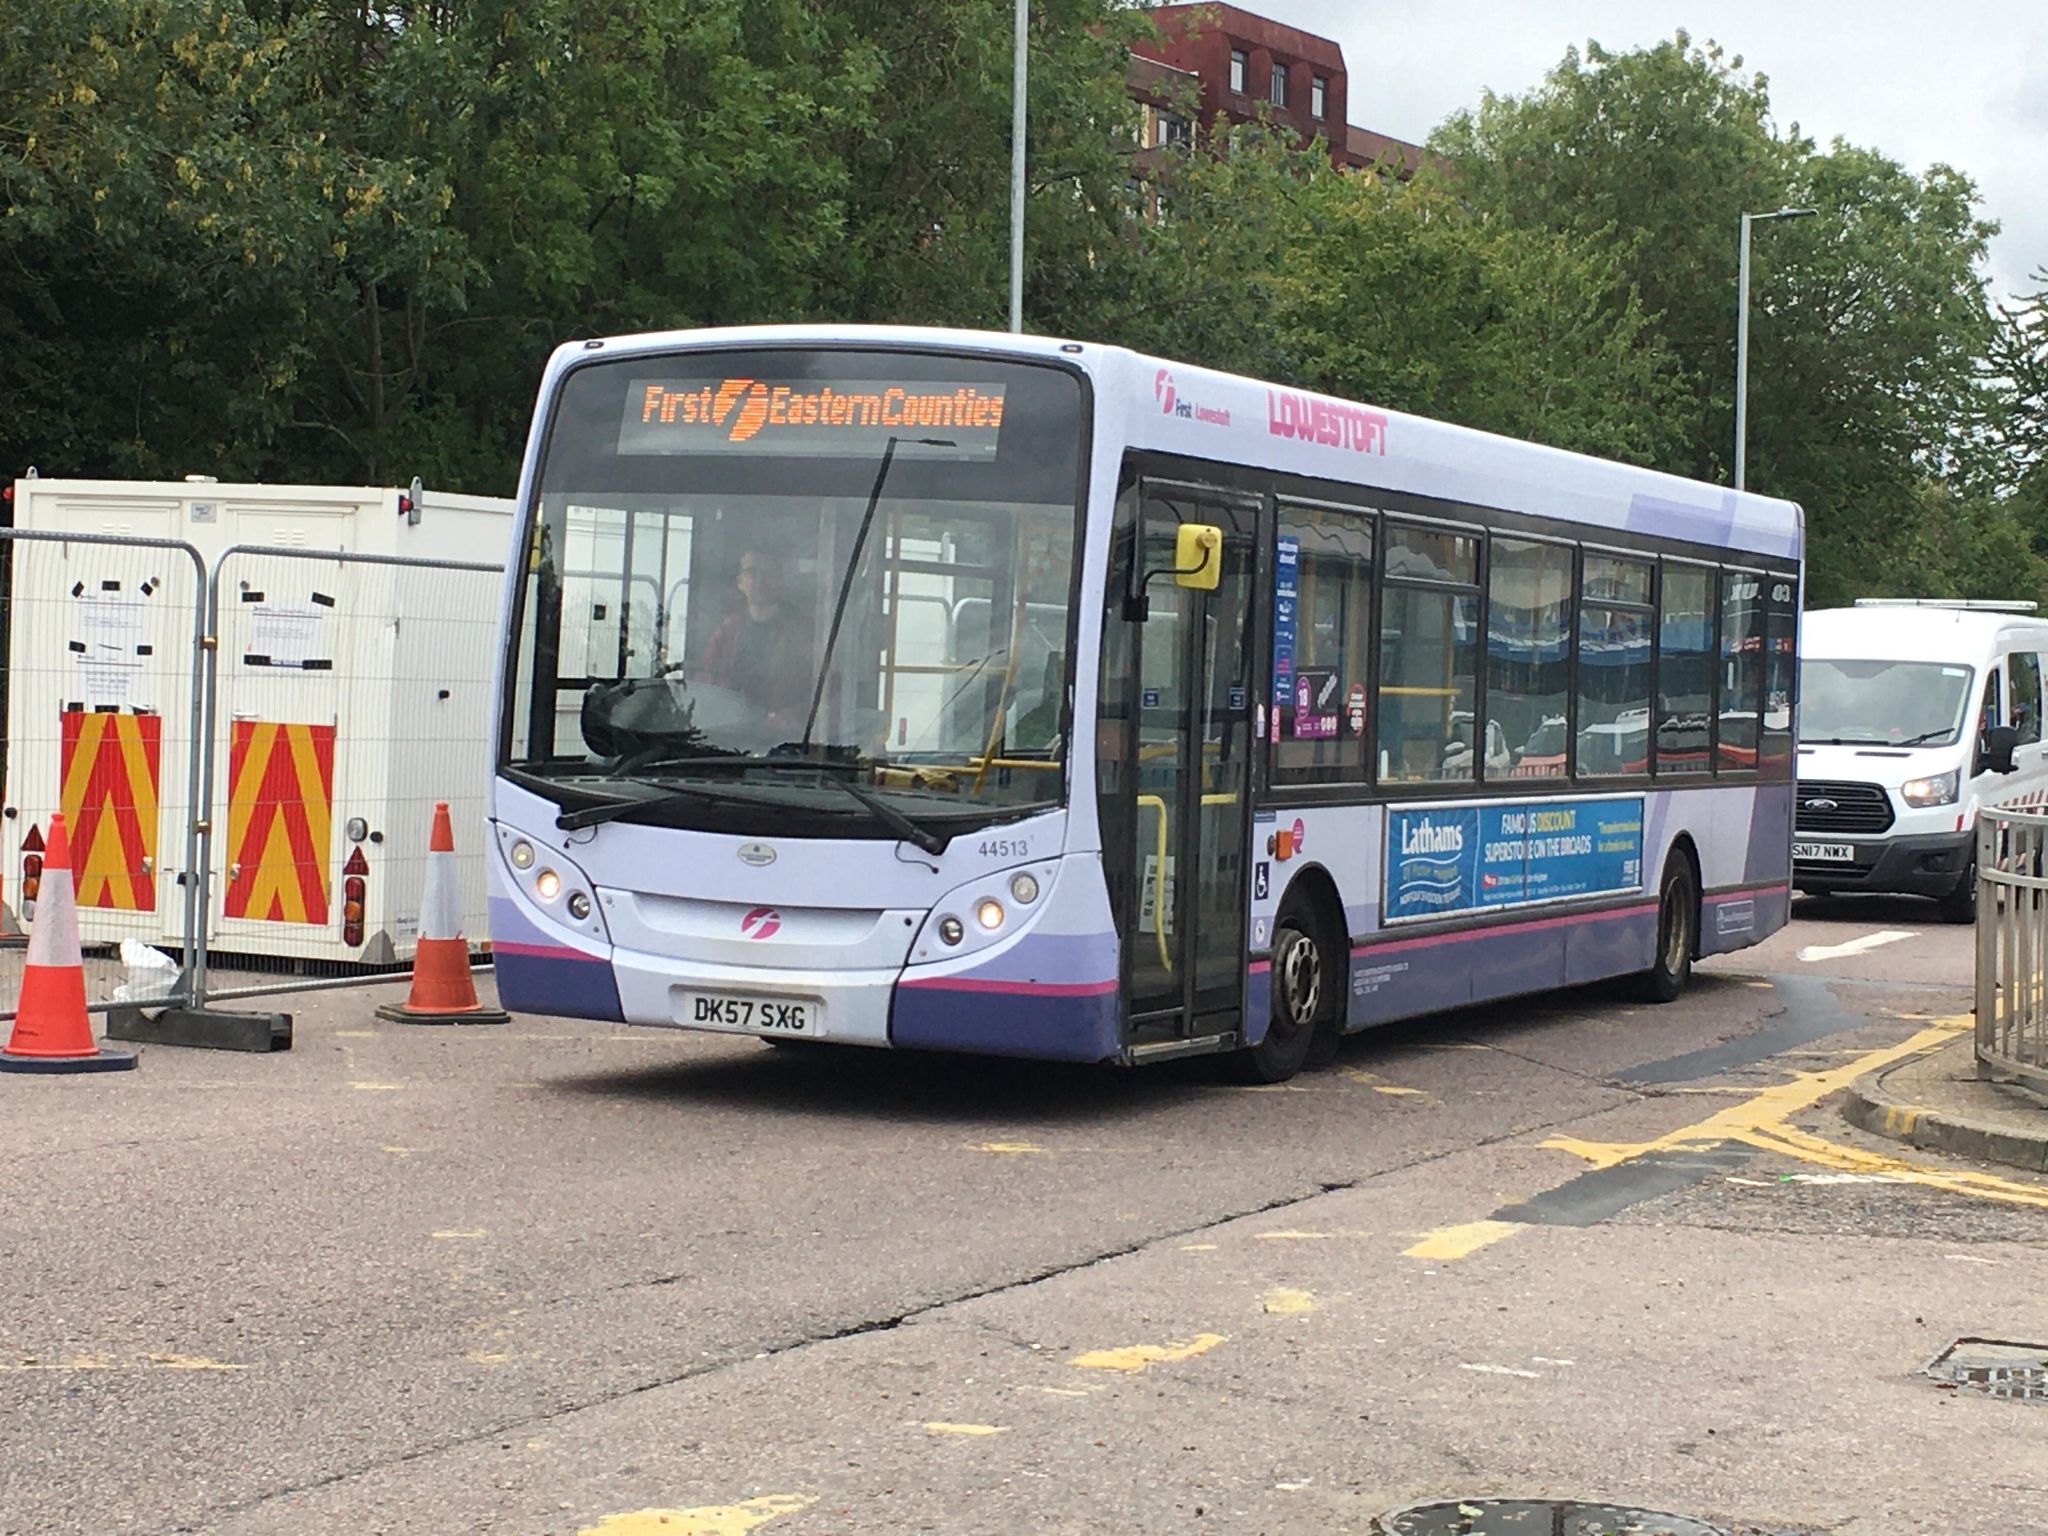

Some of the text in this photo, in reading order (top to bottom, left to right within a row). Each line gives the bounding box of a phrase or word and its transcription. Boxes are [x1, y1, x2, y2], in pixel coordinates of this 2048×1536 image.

[642, 386, 712, 423] First
[1267, 390, 1388, 456] LOWESTOFT
[1537, 809, 1576, 832] DISCOUNT
[978, 840, 1029, 858] 44513
[1401, 817, 1462, 854] Lathams
[1534, 839, 1546, 858] ON
[1547, 837, 1560, 857] THE
[1793, 844, 1821, 857] SN17
[694, 996, 806, 1030] DK57 SXG
